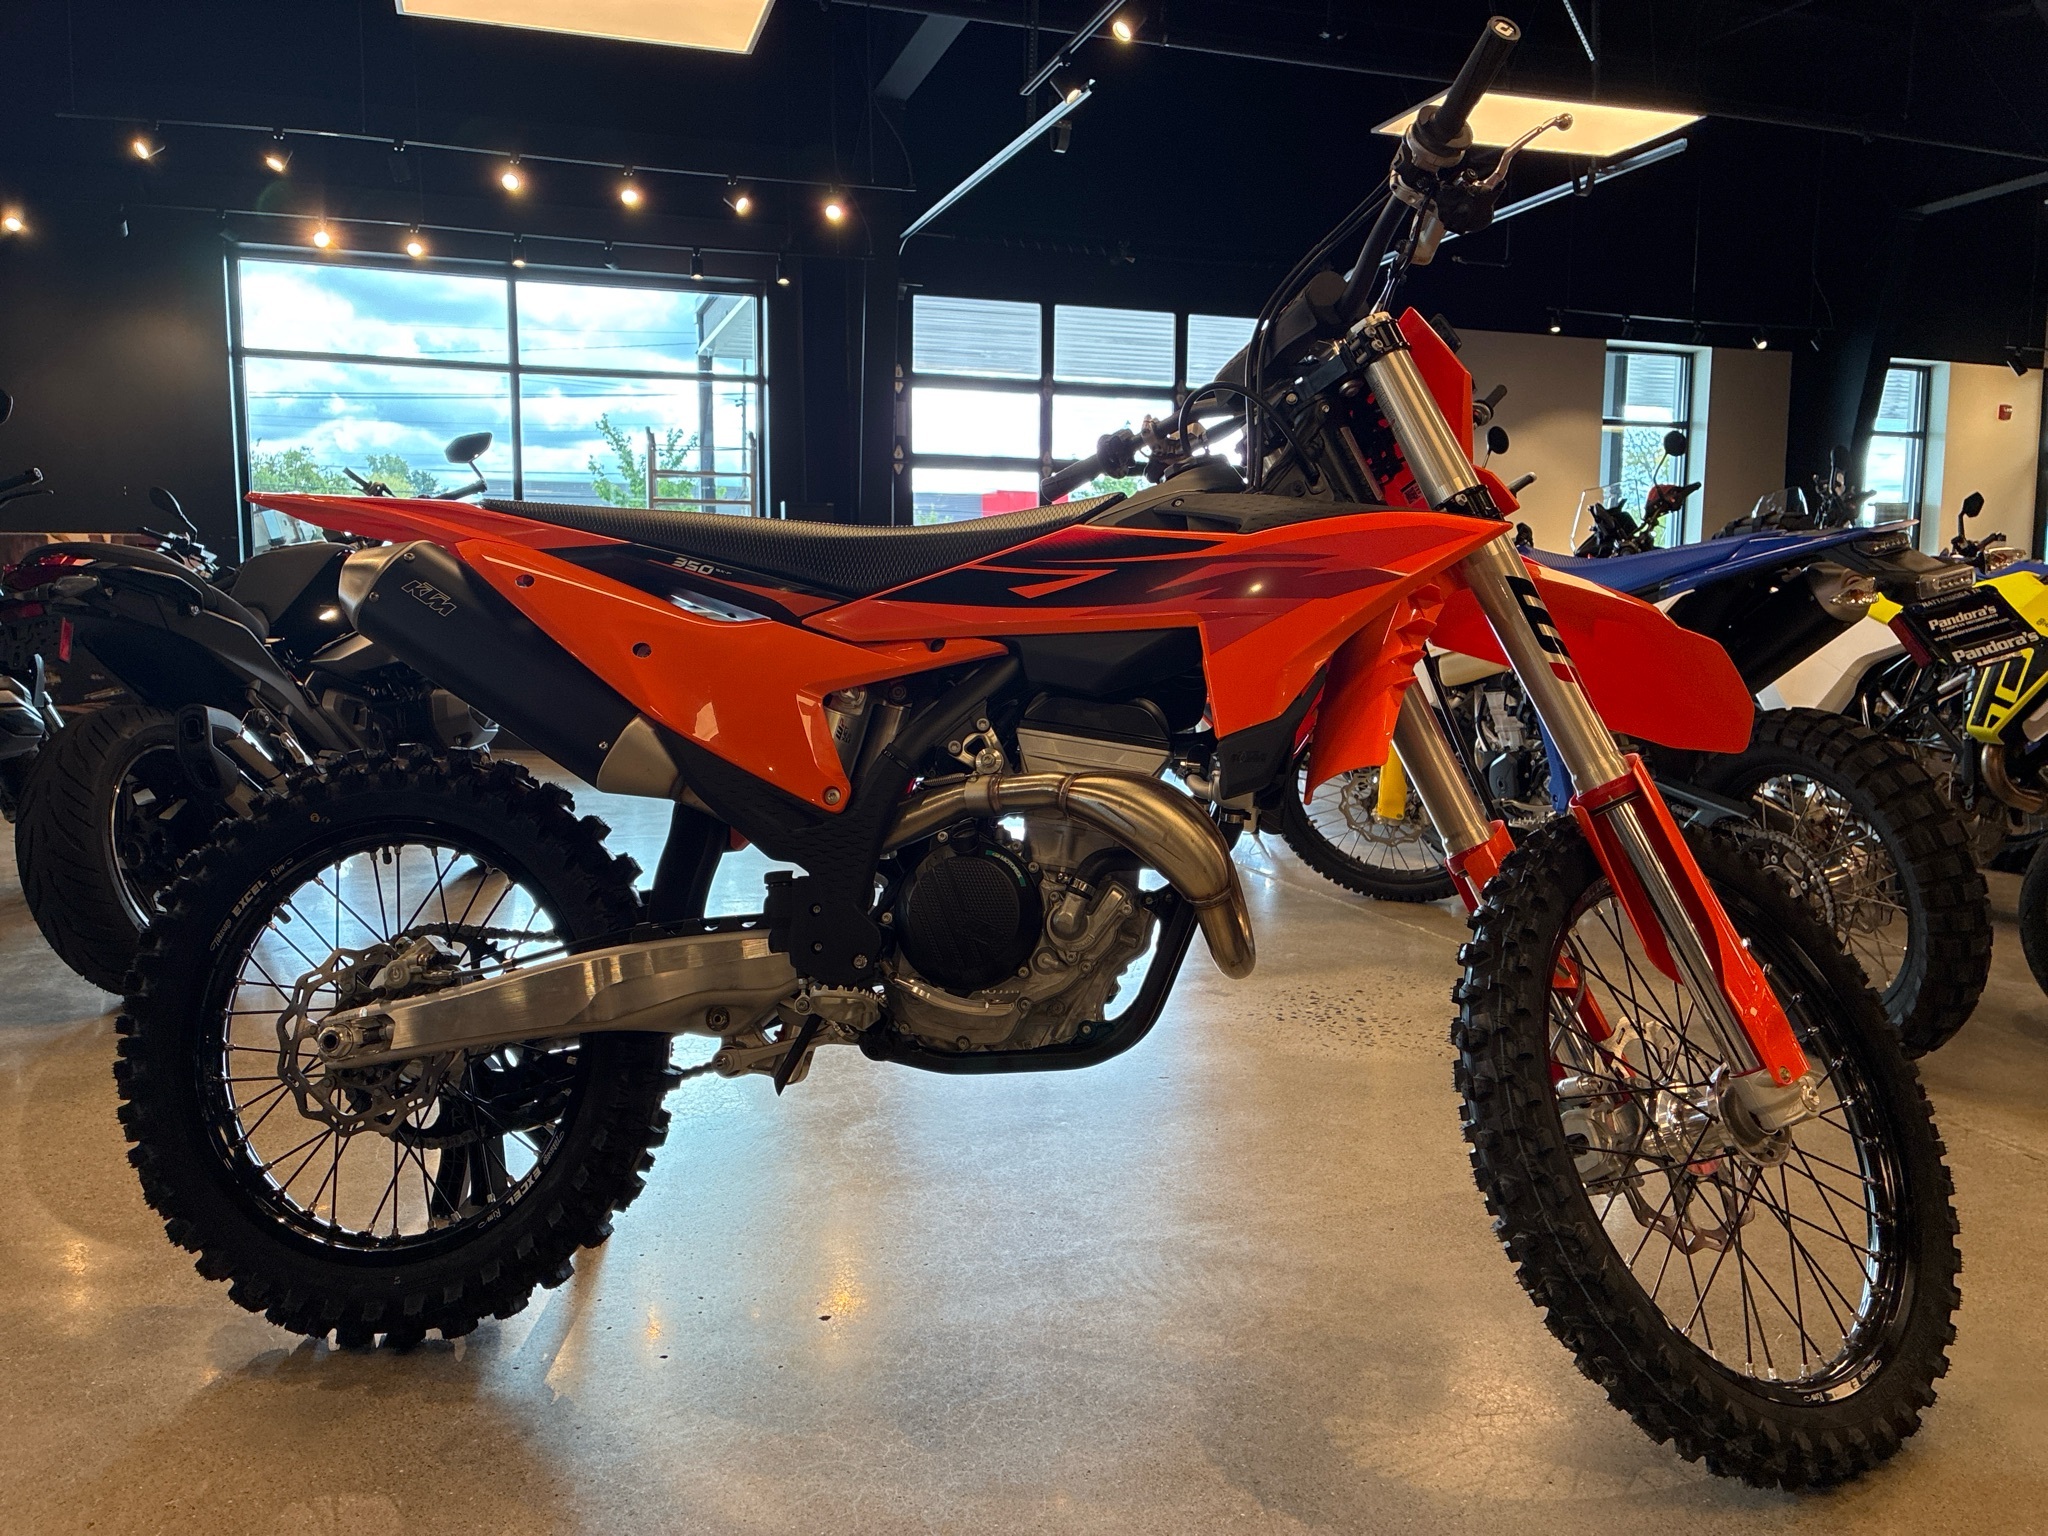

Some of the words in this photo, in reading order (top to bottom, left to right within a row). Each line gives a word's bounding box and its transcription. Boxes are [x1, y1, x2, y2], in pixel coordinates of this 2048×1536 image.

[672, 557, 715, 575] 350
[401, 580, 457, 617] KTM
[1928, 605, 1997, 631] Pandora's
[1951, 631, 2040, 663] Pandora's
[231, 880, 268, 917] EXCEL
[505, 1166, 542, 1206] EXCEL
